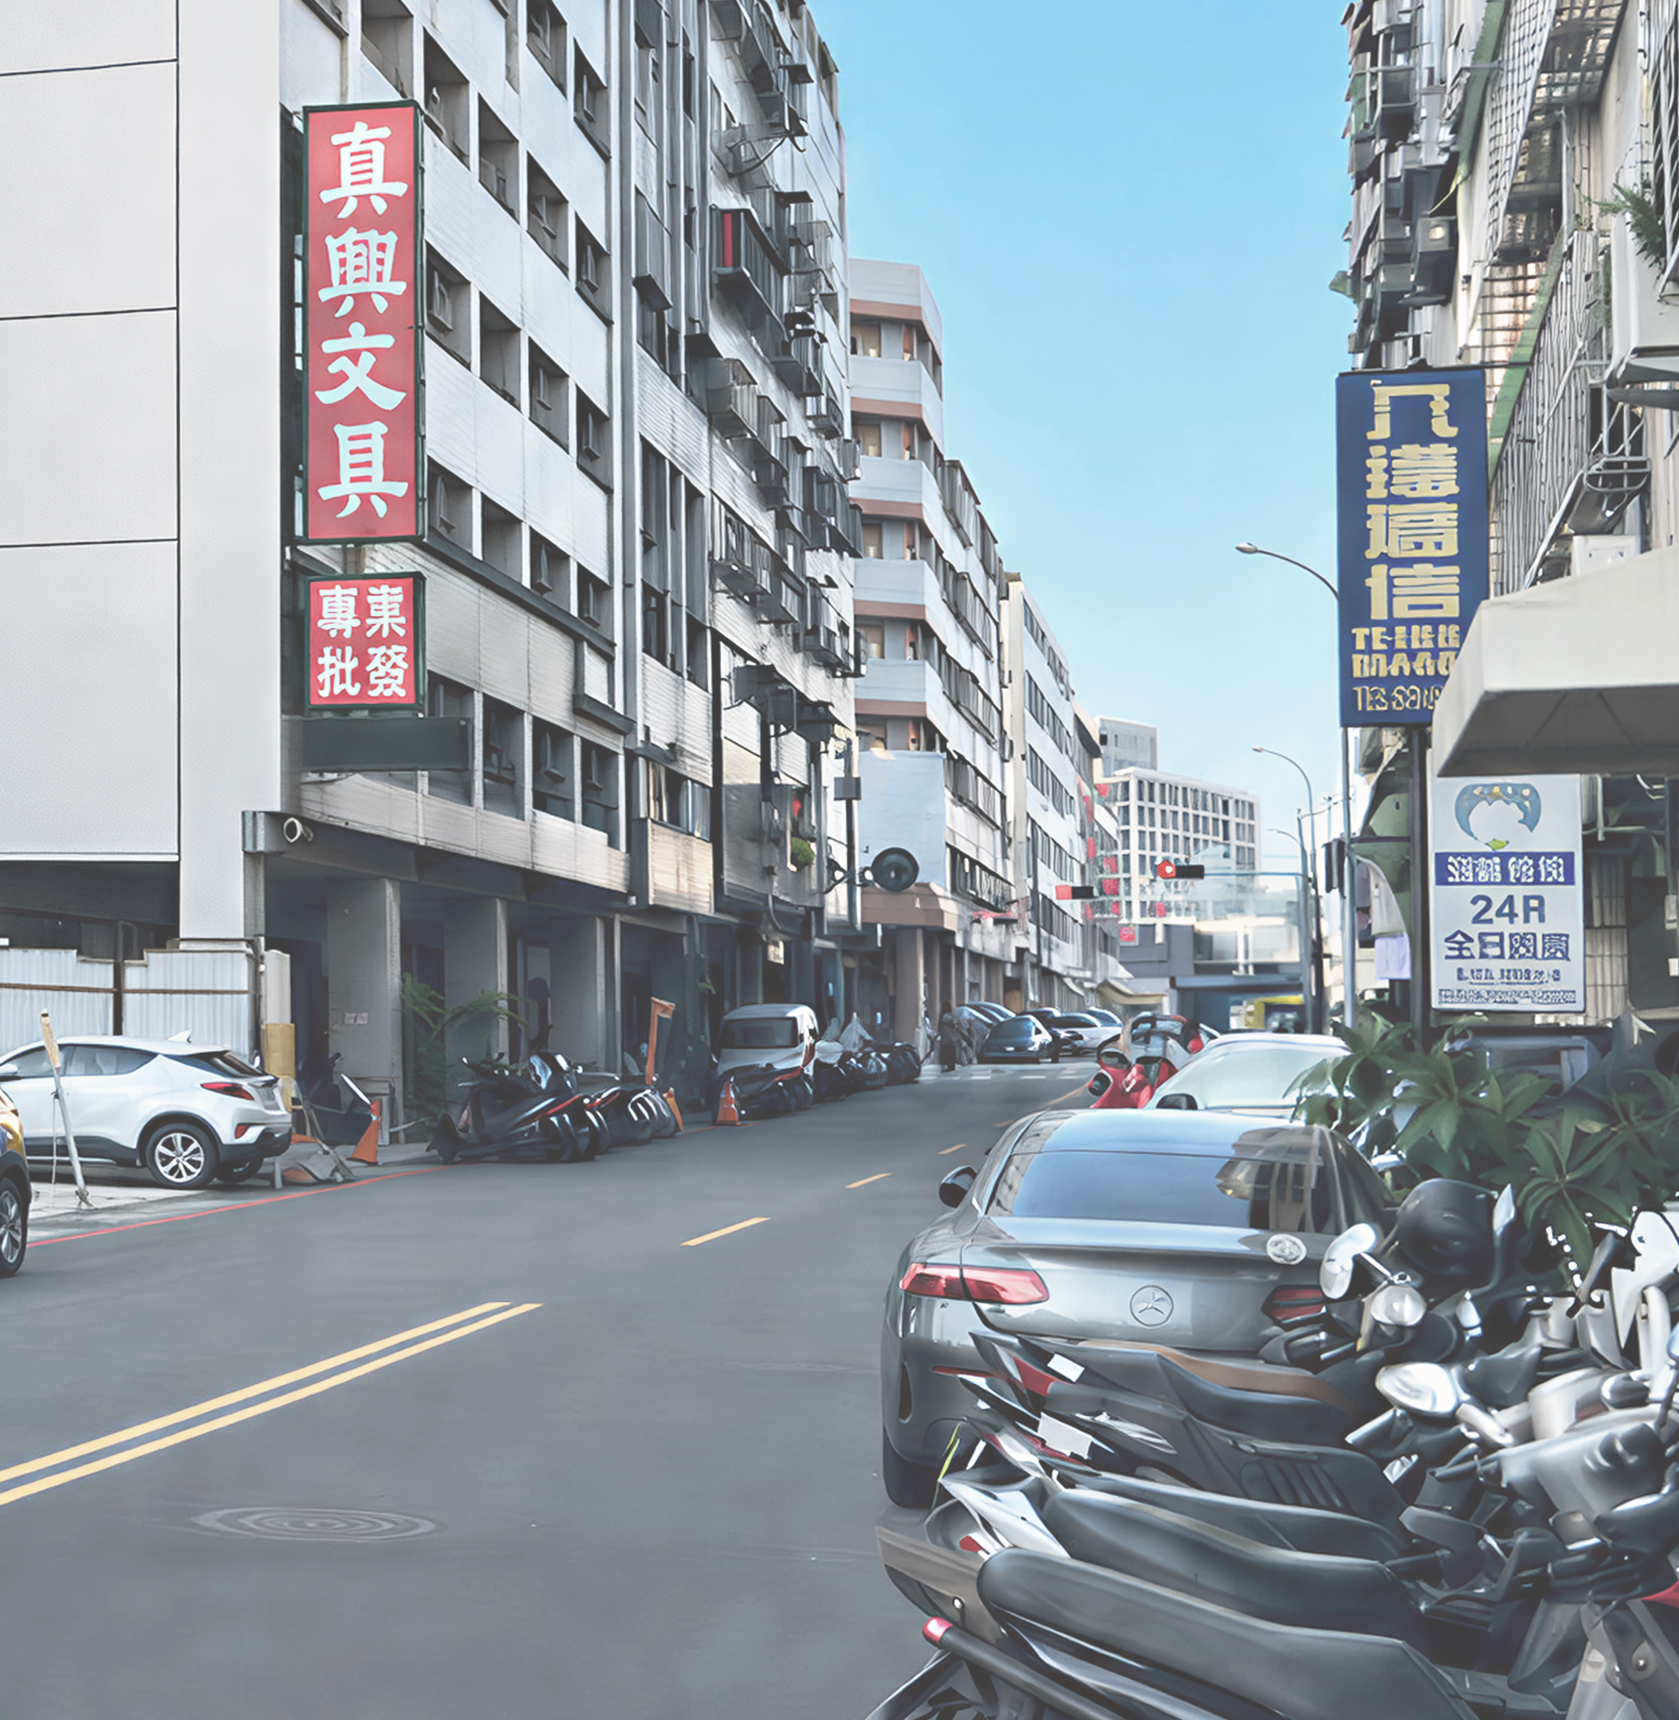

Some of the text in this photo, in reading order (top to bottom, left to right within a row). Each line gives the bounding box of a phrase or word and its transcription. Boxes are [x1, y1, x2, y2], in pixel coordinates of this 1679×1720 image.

[314, 121, 408, 518] 真興文具
[317, 644, 409, 698] 批發
